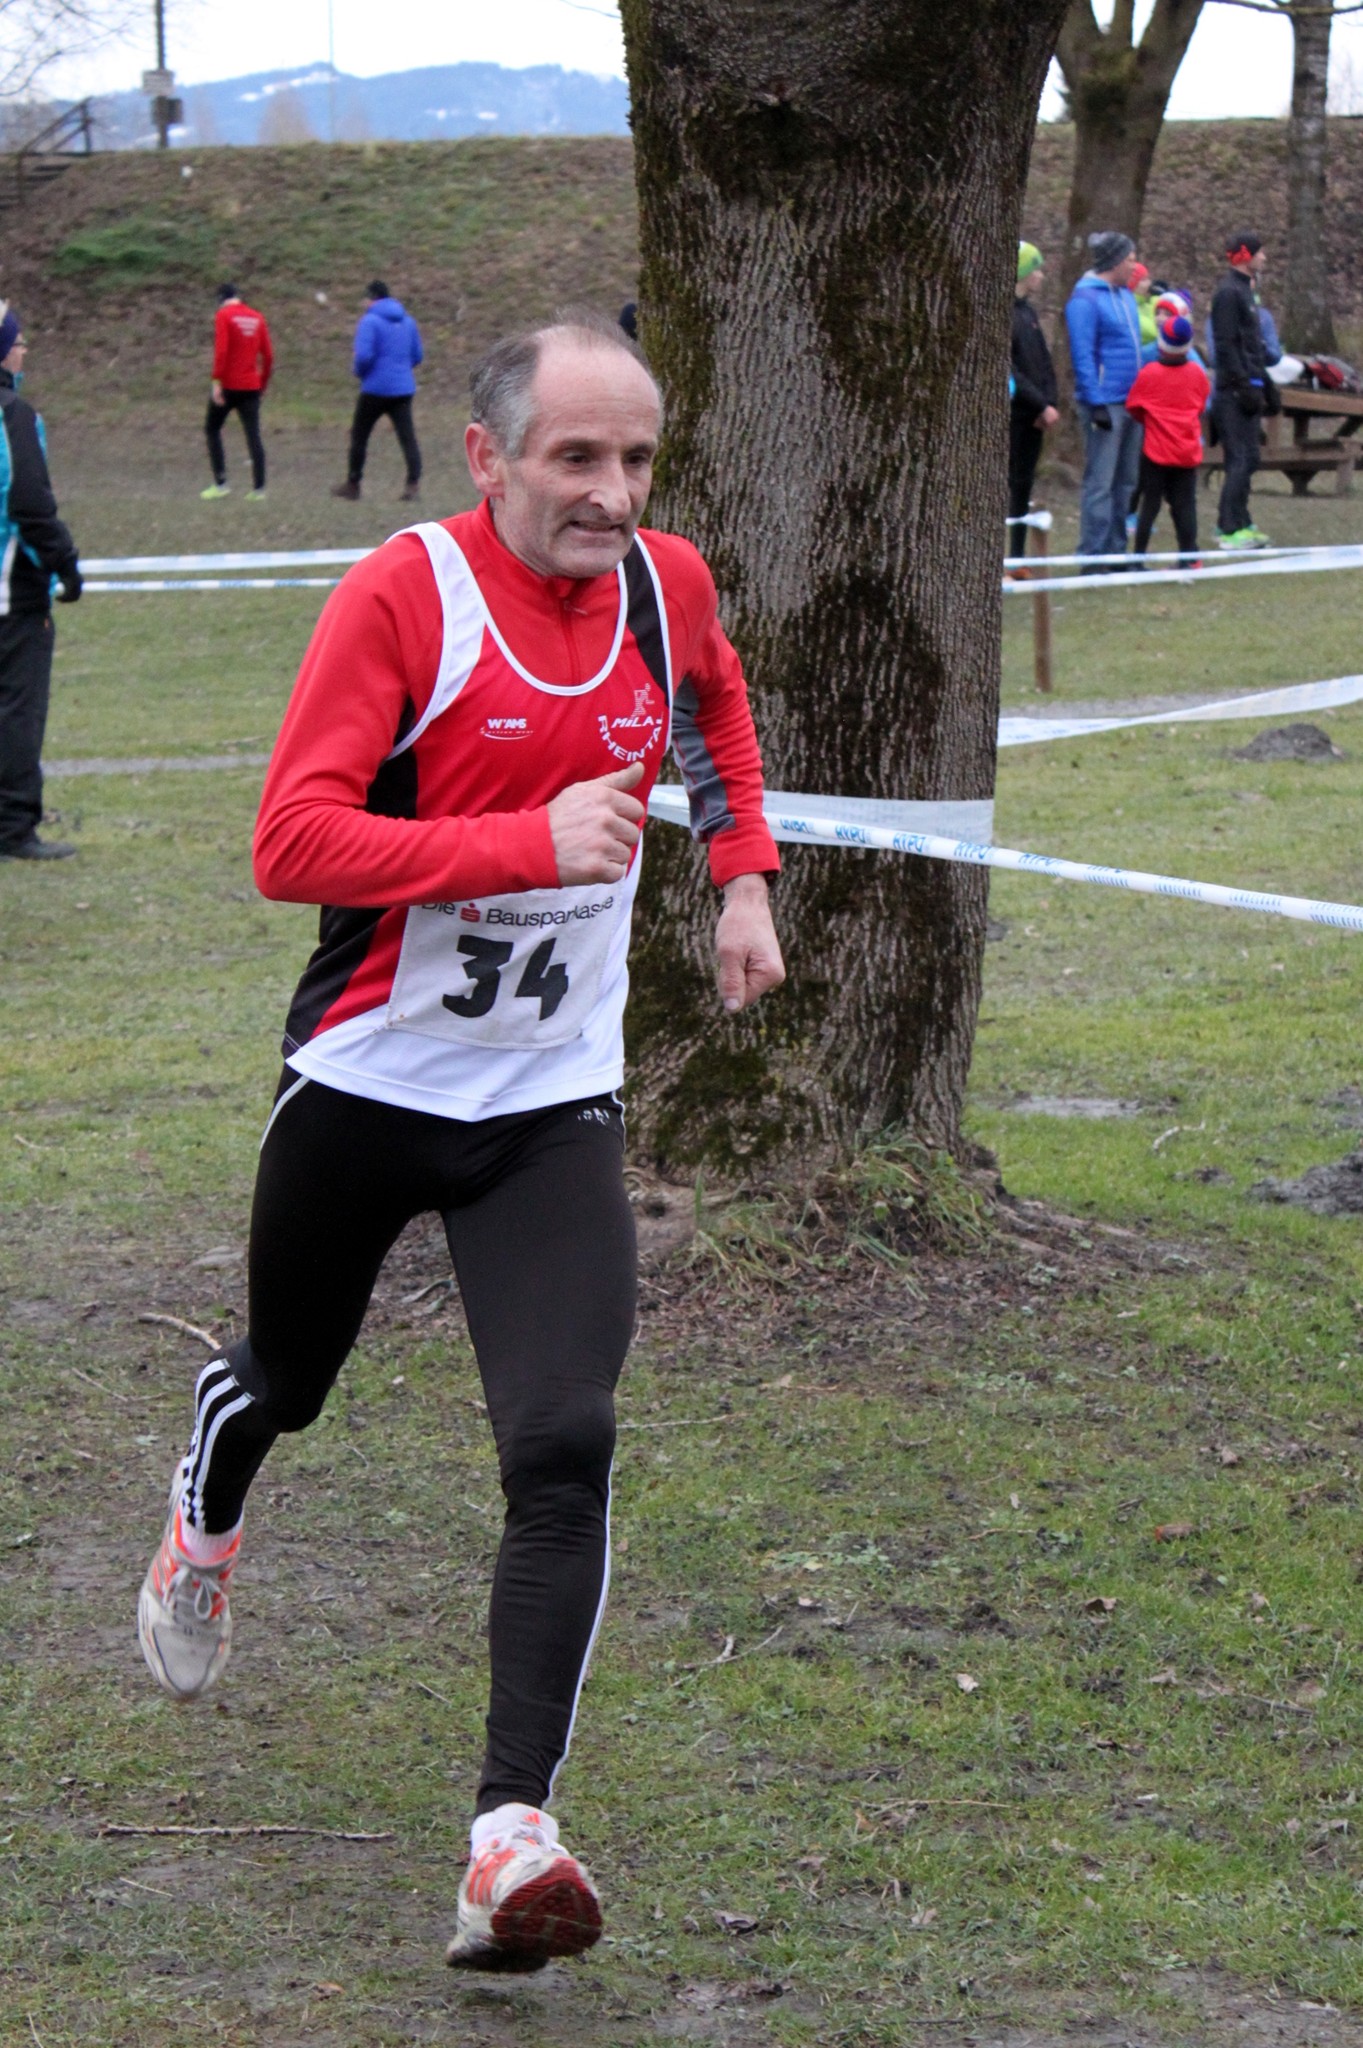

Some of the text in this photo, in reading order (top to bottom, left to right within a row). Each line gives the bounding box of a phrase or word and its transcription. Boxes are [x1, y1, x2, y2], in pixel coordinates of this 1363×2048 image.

[834, 824, 866, 844] HYPO
[892, 832, 927, 853] HYPO
[441, 934, 570, 1022] 34
